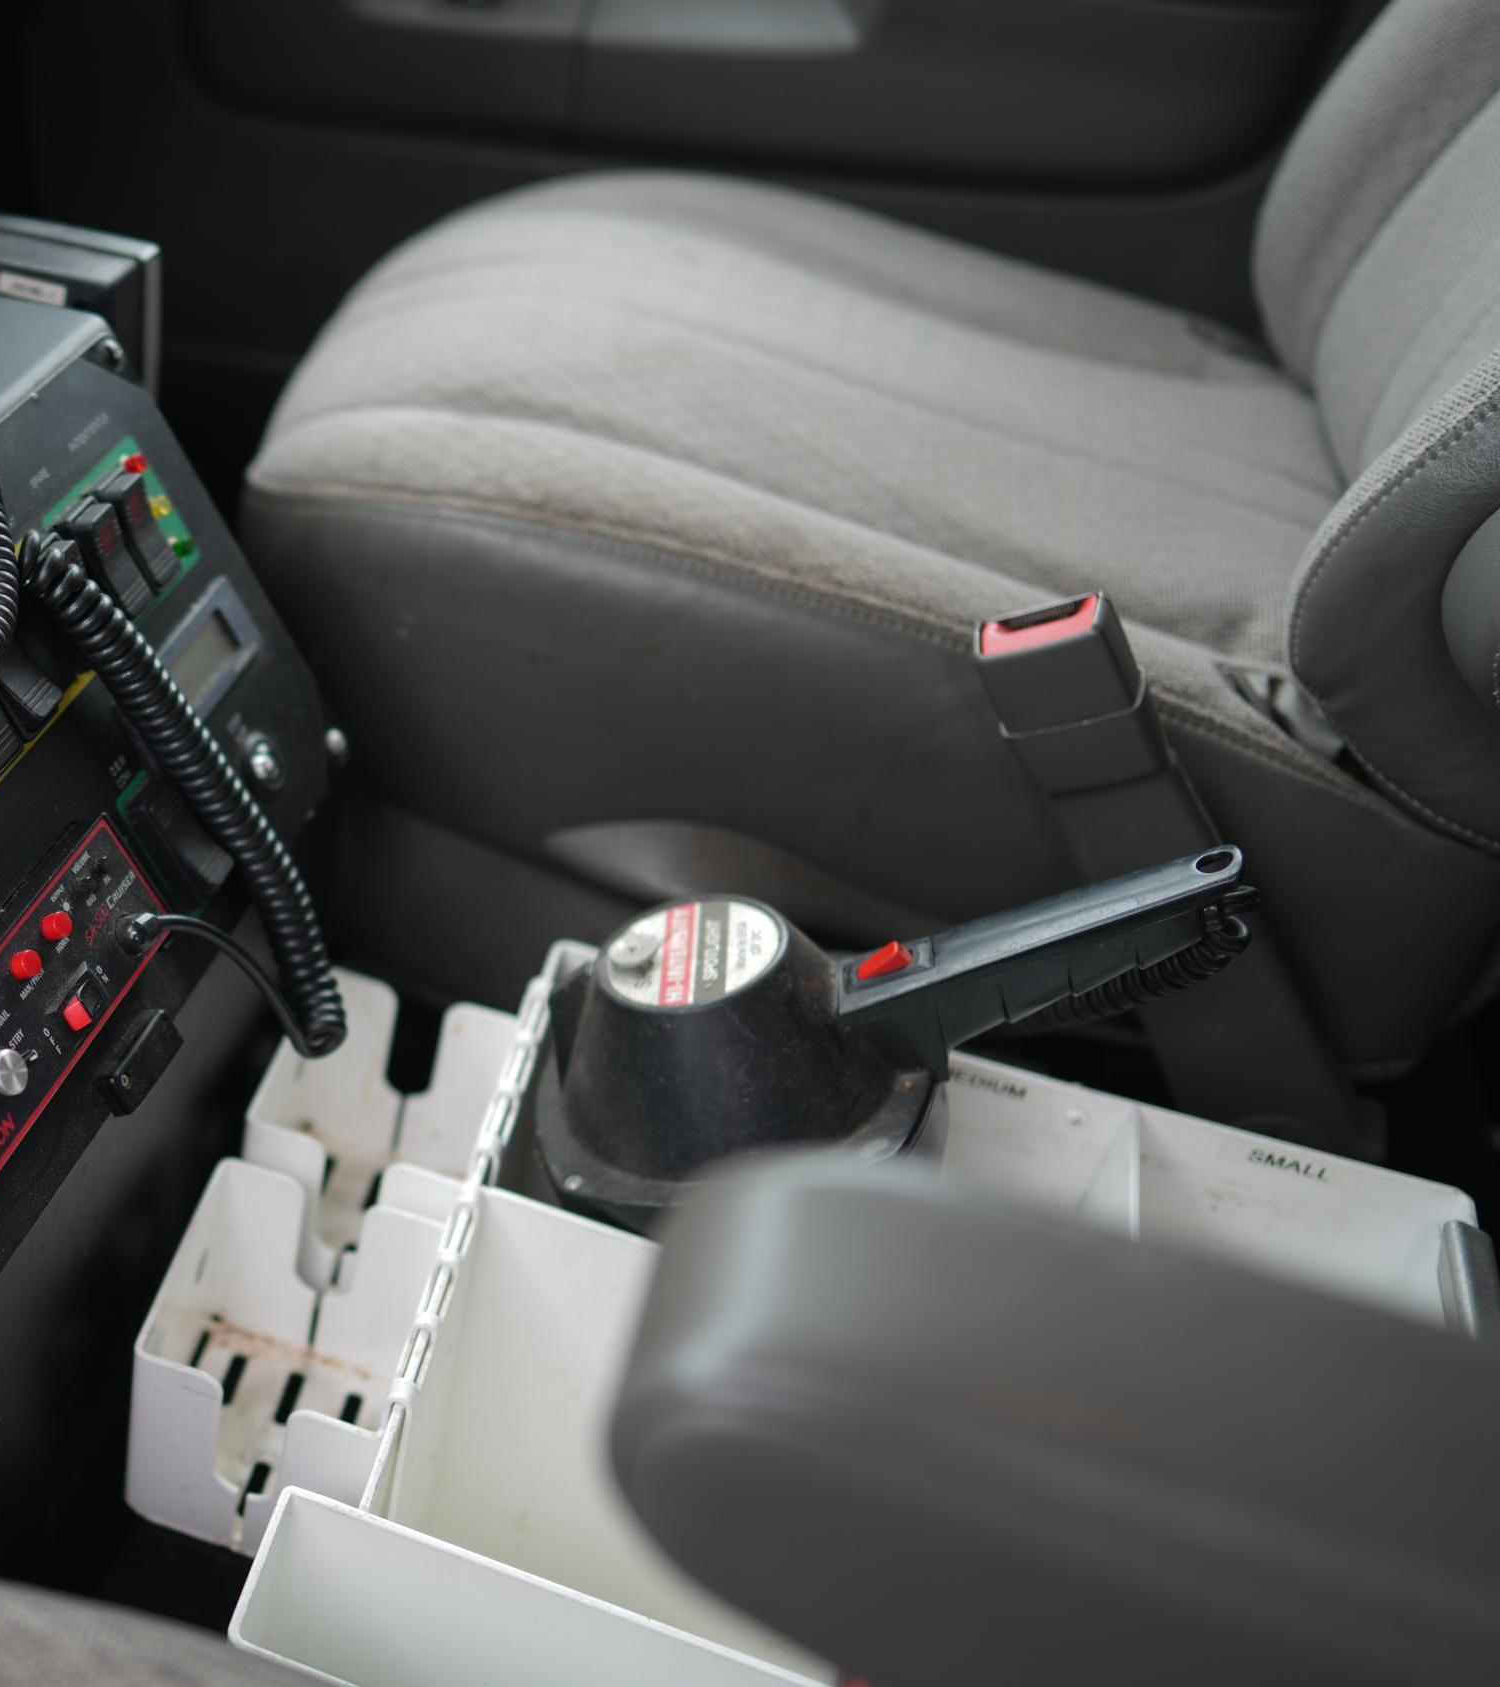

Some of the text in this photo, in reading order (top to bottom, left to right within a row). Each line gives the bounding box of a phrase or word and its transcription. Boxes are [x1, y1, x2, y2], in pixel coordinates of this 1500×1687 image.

[71, 851, 91, 875] VOLUME
[56, 935, 71, 954] HORN
[702, 919, 722, 981] SPOTLIGHT
[8, 1027, 25, 1050] STBY
[1247, 1147, 1331, 1183] SMALL
